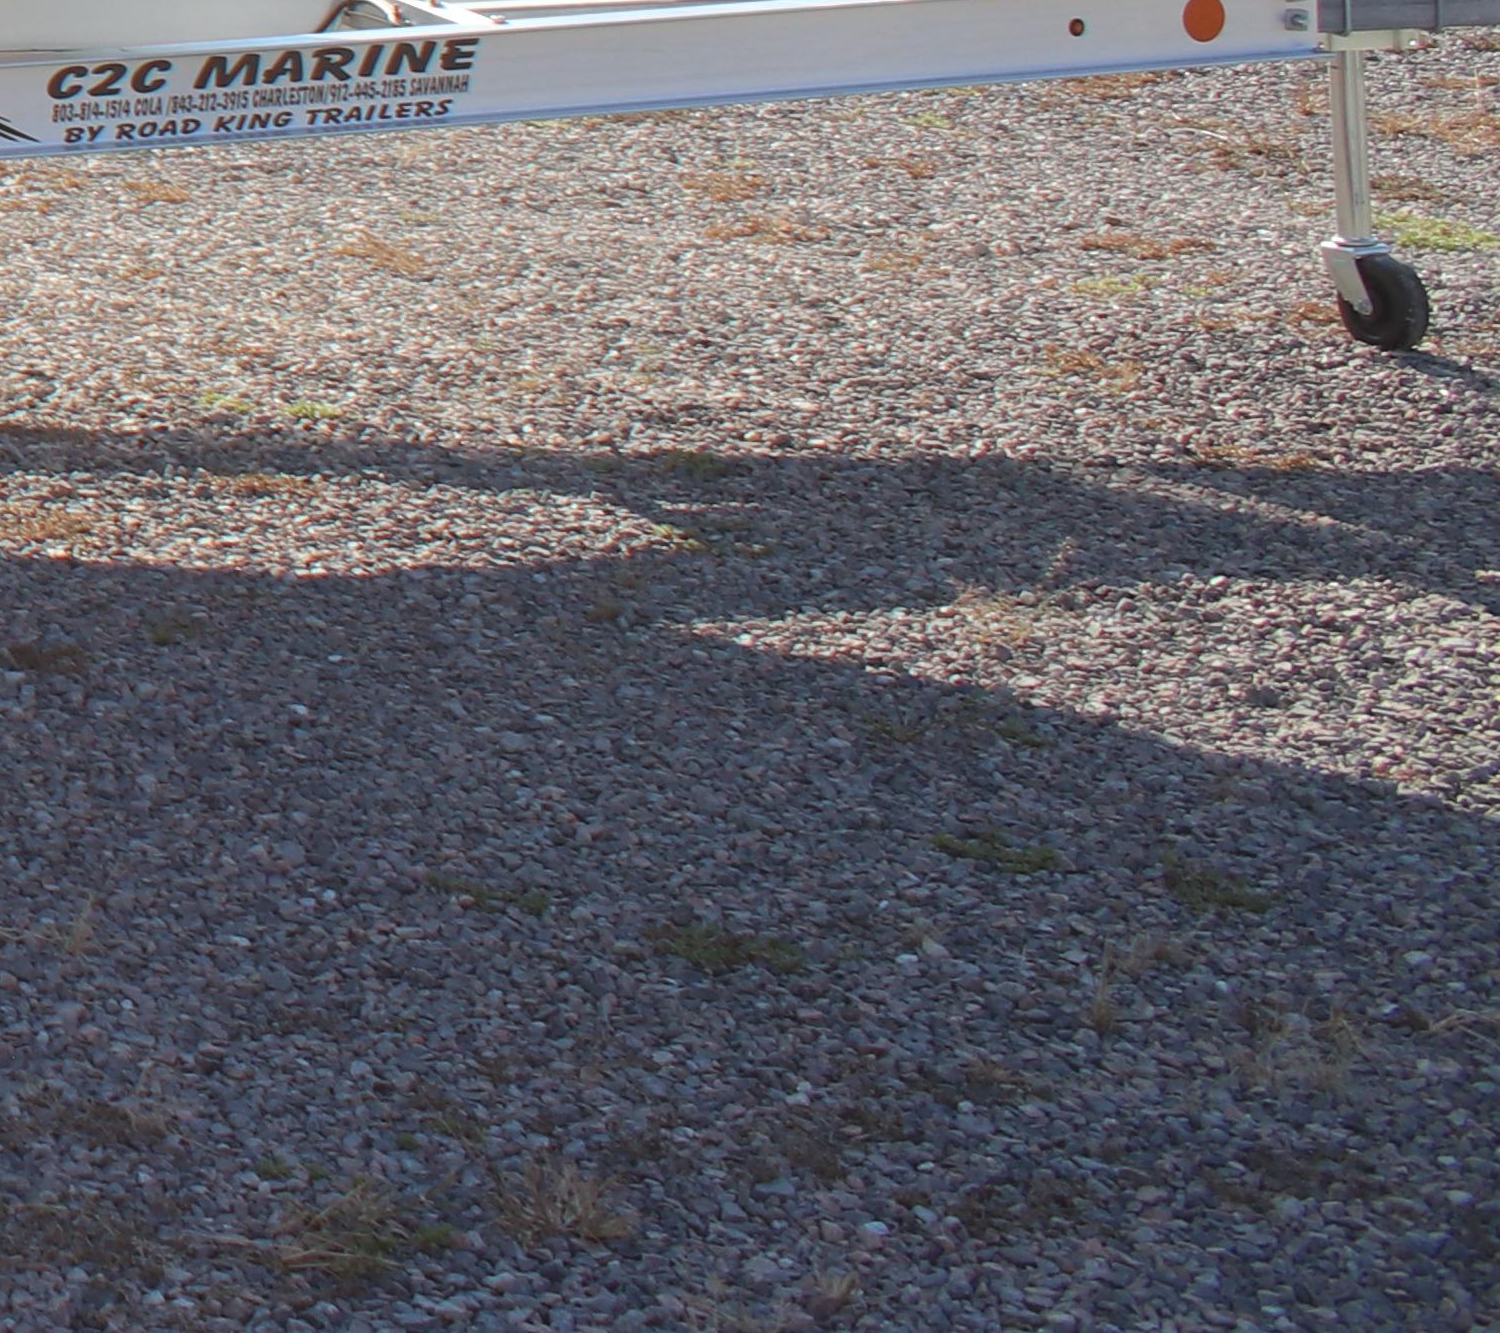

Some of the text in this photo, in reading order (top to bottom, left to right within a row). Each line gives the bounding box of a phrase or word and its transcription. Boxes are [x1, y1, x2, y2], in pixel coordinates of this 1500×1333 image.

[47, 38, 480, 100] C2C MARINE
[133, 97, 162, 117] COLA
[409, 74, 470, 97] SAVANNAH
[63, 99, 454, 144] BY ROAD KING TRAILERS
